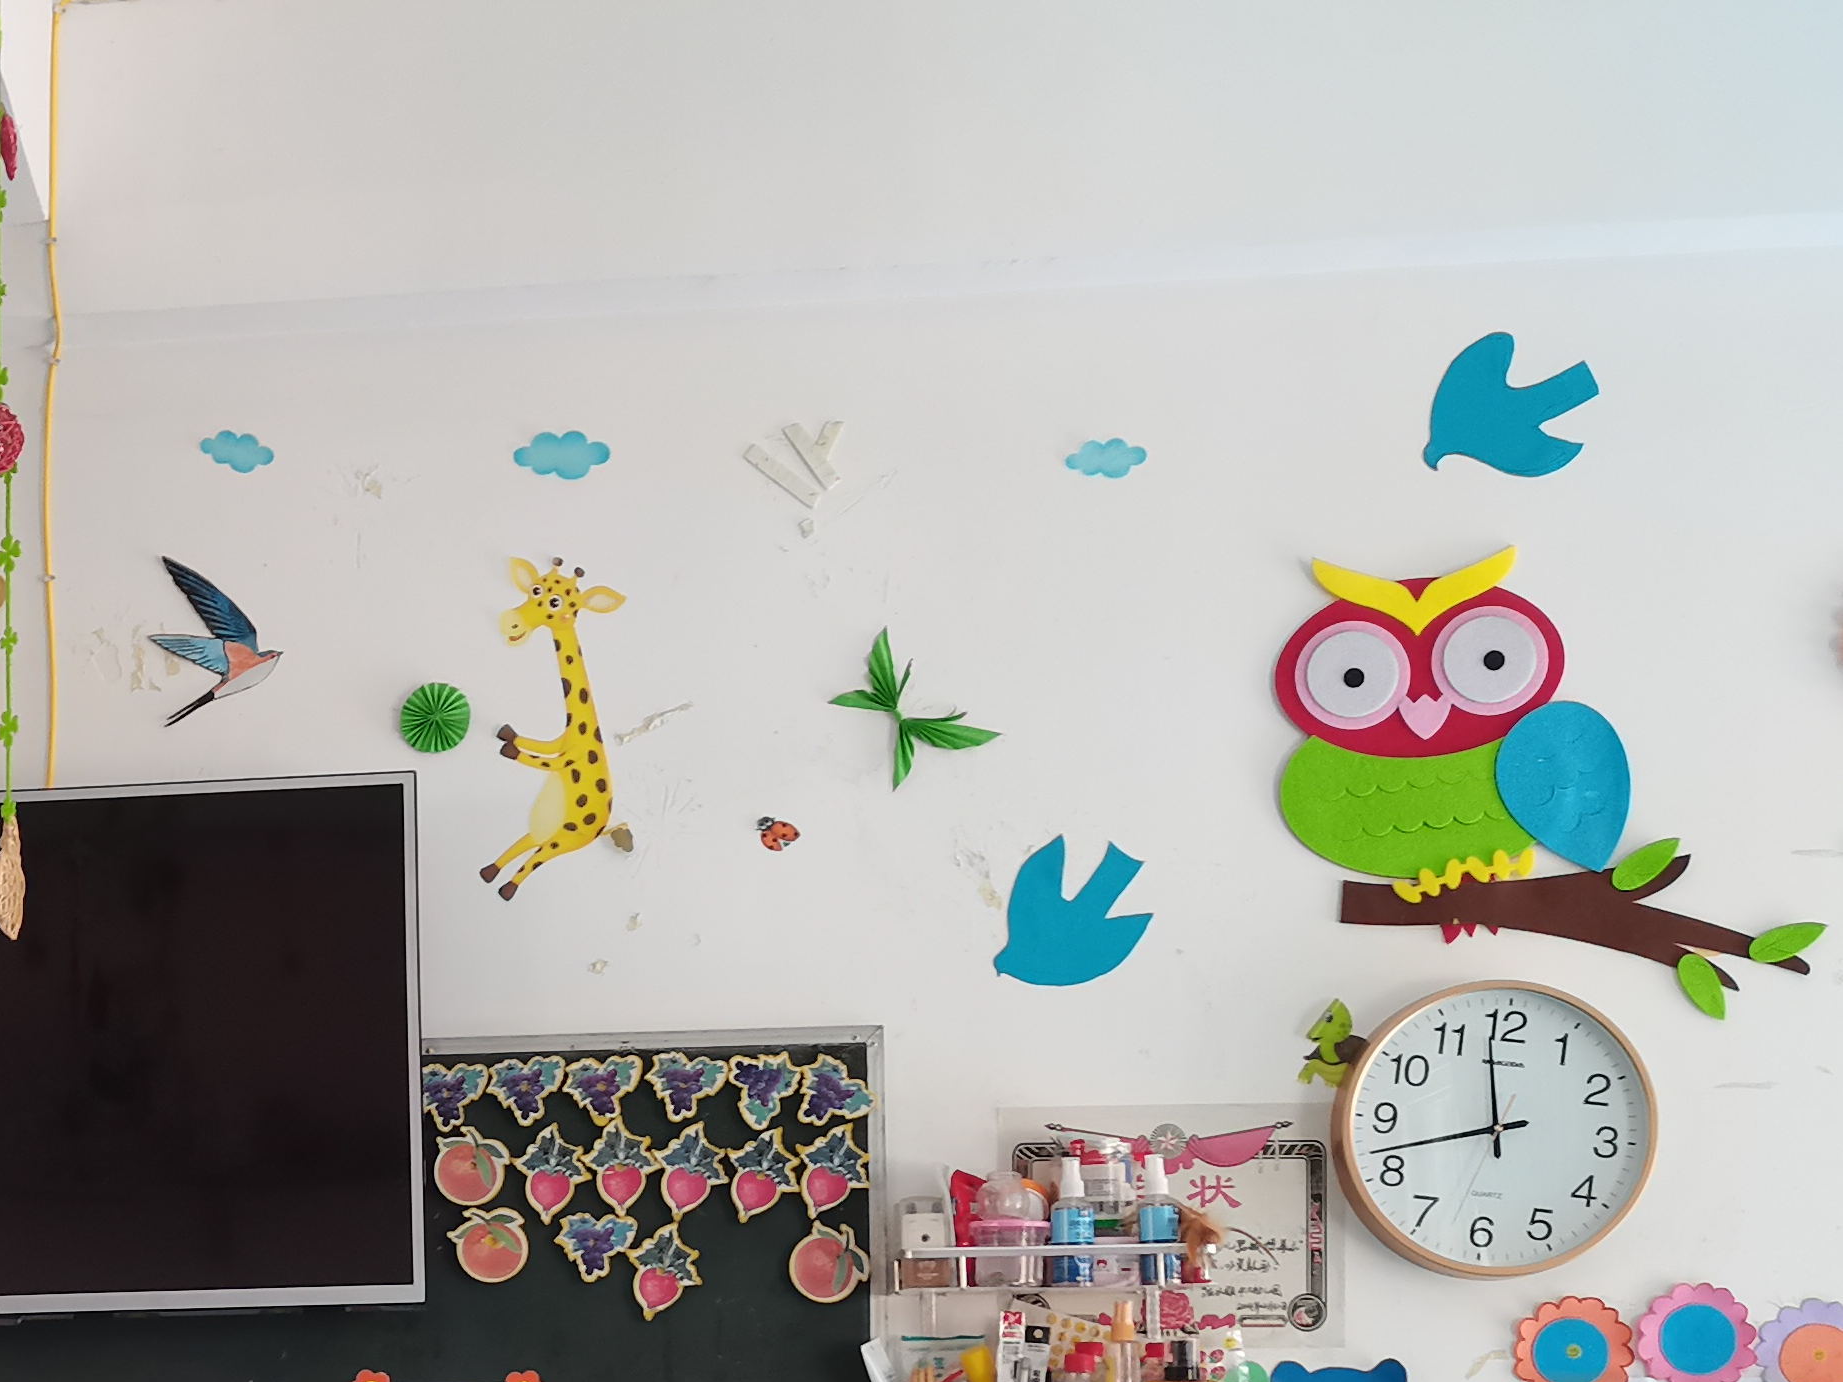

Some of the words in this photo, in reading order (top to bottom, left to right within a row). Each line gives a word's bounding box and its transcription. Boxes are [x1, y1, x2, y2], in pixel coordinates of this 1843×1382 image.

[1433, 1021, 1466, 1057] 11
[1485, 1008, 1528, 1044] 12
[1554, 1033, 1569, 1066] 1
[1390, 1053, 1430, 1087] 10
[1582, 1073, 1612, 1107] 2
[1371, 1101, 1399, 1134] 9
[1592, 1125, 1619, 1159] 3
[1379, 1154, 1405, 1187] 8
[1570, 1174, 1599, 1208] 4
[1412, 1194, 1440, 1228] 7
[1526, 1207, 1554, 1241] 5
[1468, 1215, 1495, 1248] 6
